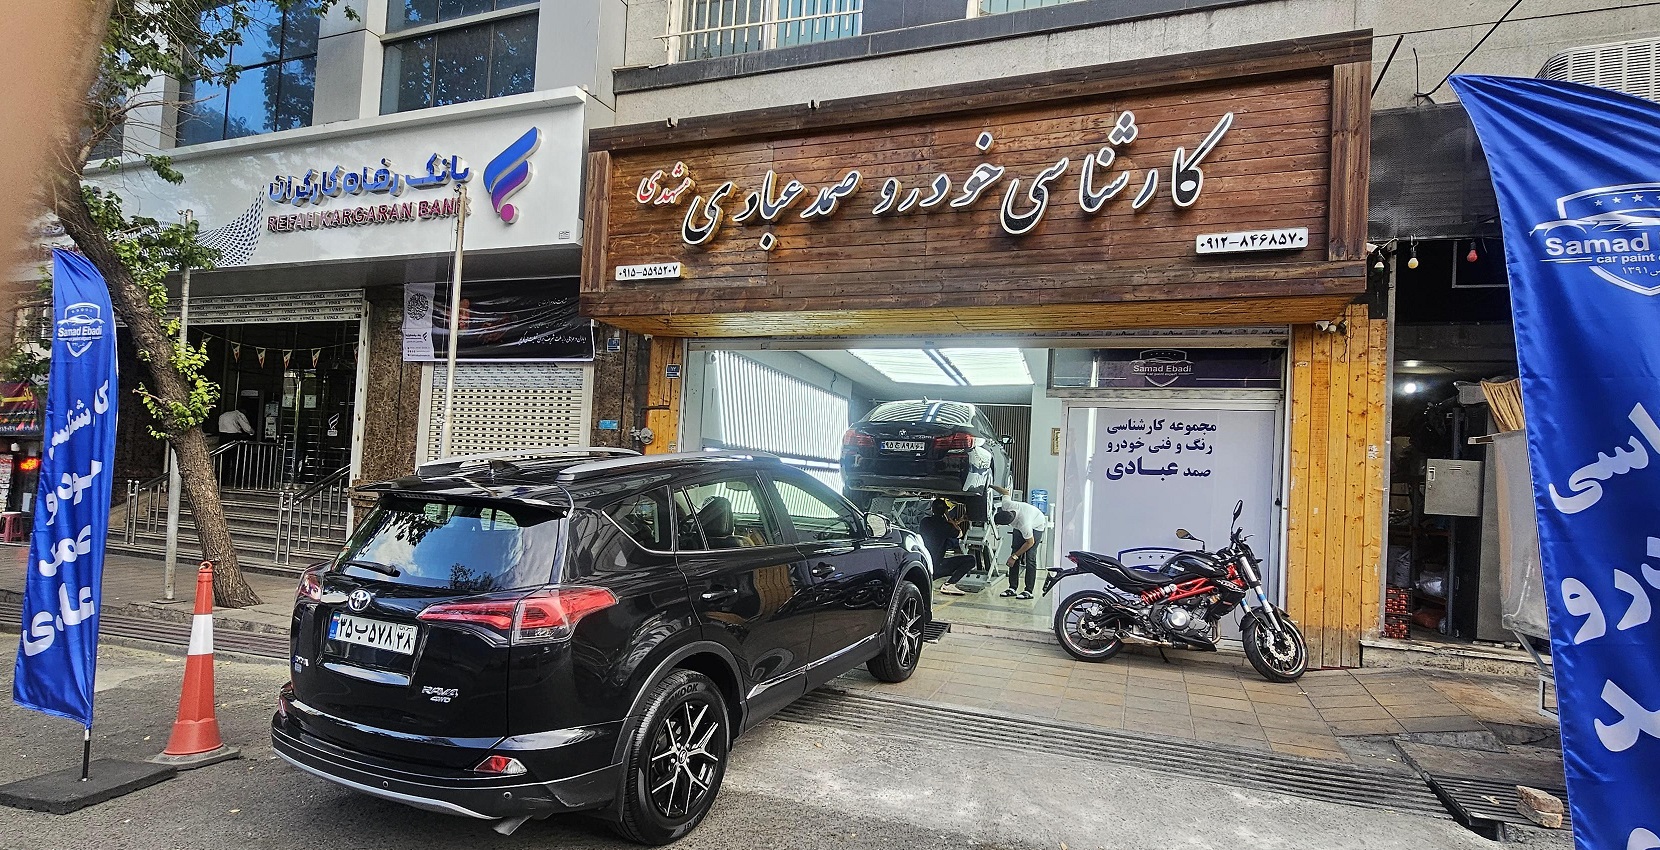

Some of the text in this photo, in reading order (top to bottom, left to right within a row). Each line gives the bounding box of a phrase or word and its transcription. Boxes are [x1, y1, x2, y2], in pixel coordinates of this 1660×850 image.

[268, 152, 472, 207] بانک رفاه کارگران
[682, 110, 1234, 251] کارشناسی خودرو صمد عبادی
[267, 212, 319, 233] REFAH
[319, 202, 417, 229] KARGARAN
[1545, 232, 1650, 256] Samad
[1596, 253, 1656, 265] car paint
[1622, 266, 1648, 275] ۱۳۹۱
[57, 325, 103, 338] Samad Ebadi
[1106, 418, 1217, 436] مجموعه کارشناسی
[1106, 436, 1213, 455] رنگ و فنی خودرو
[1106, 456, 1211, 481] صمد عبادی
[421, 685, 459, 698] RAV4
